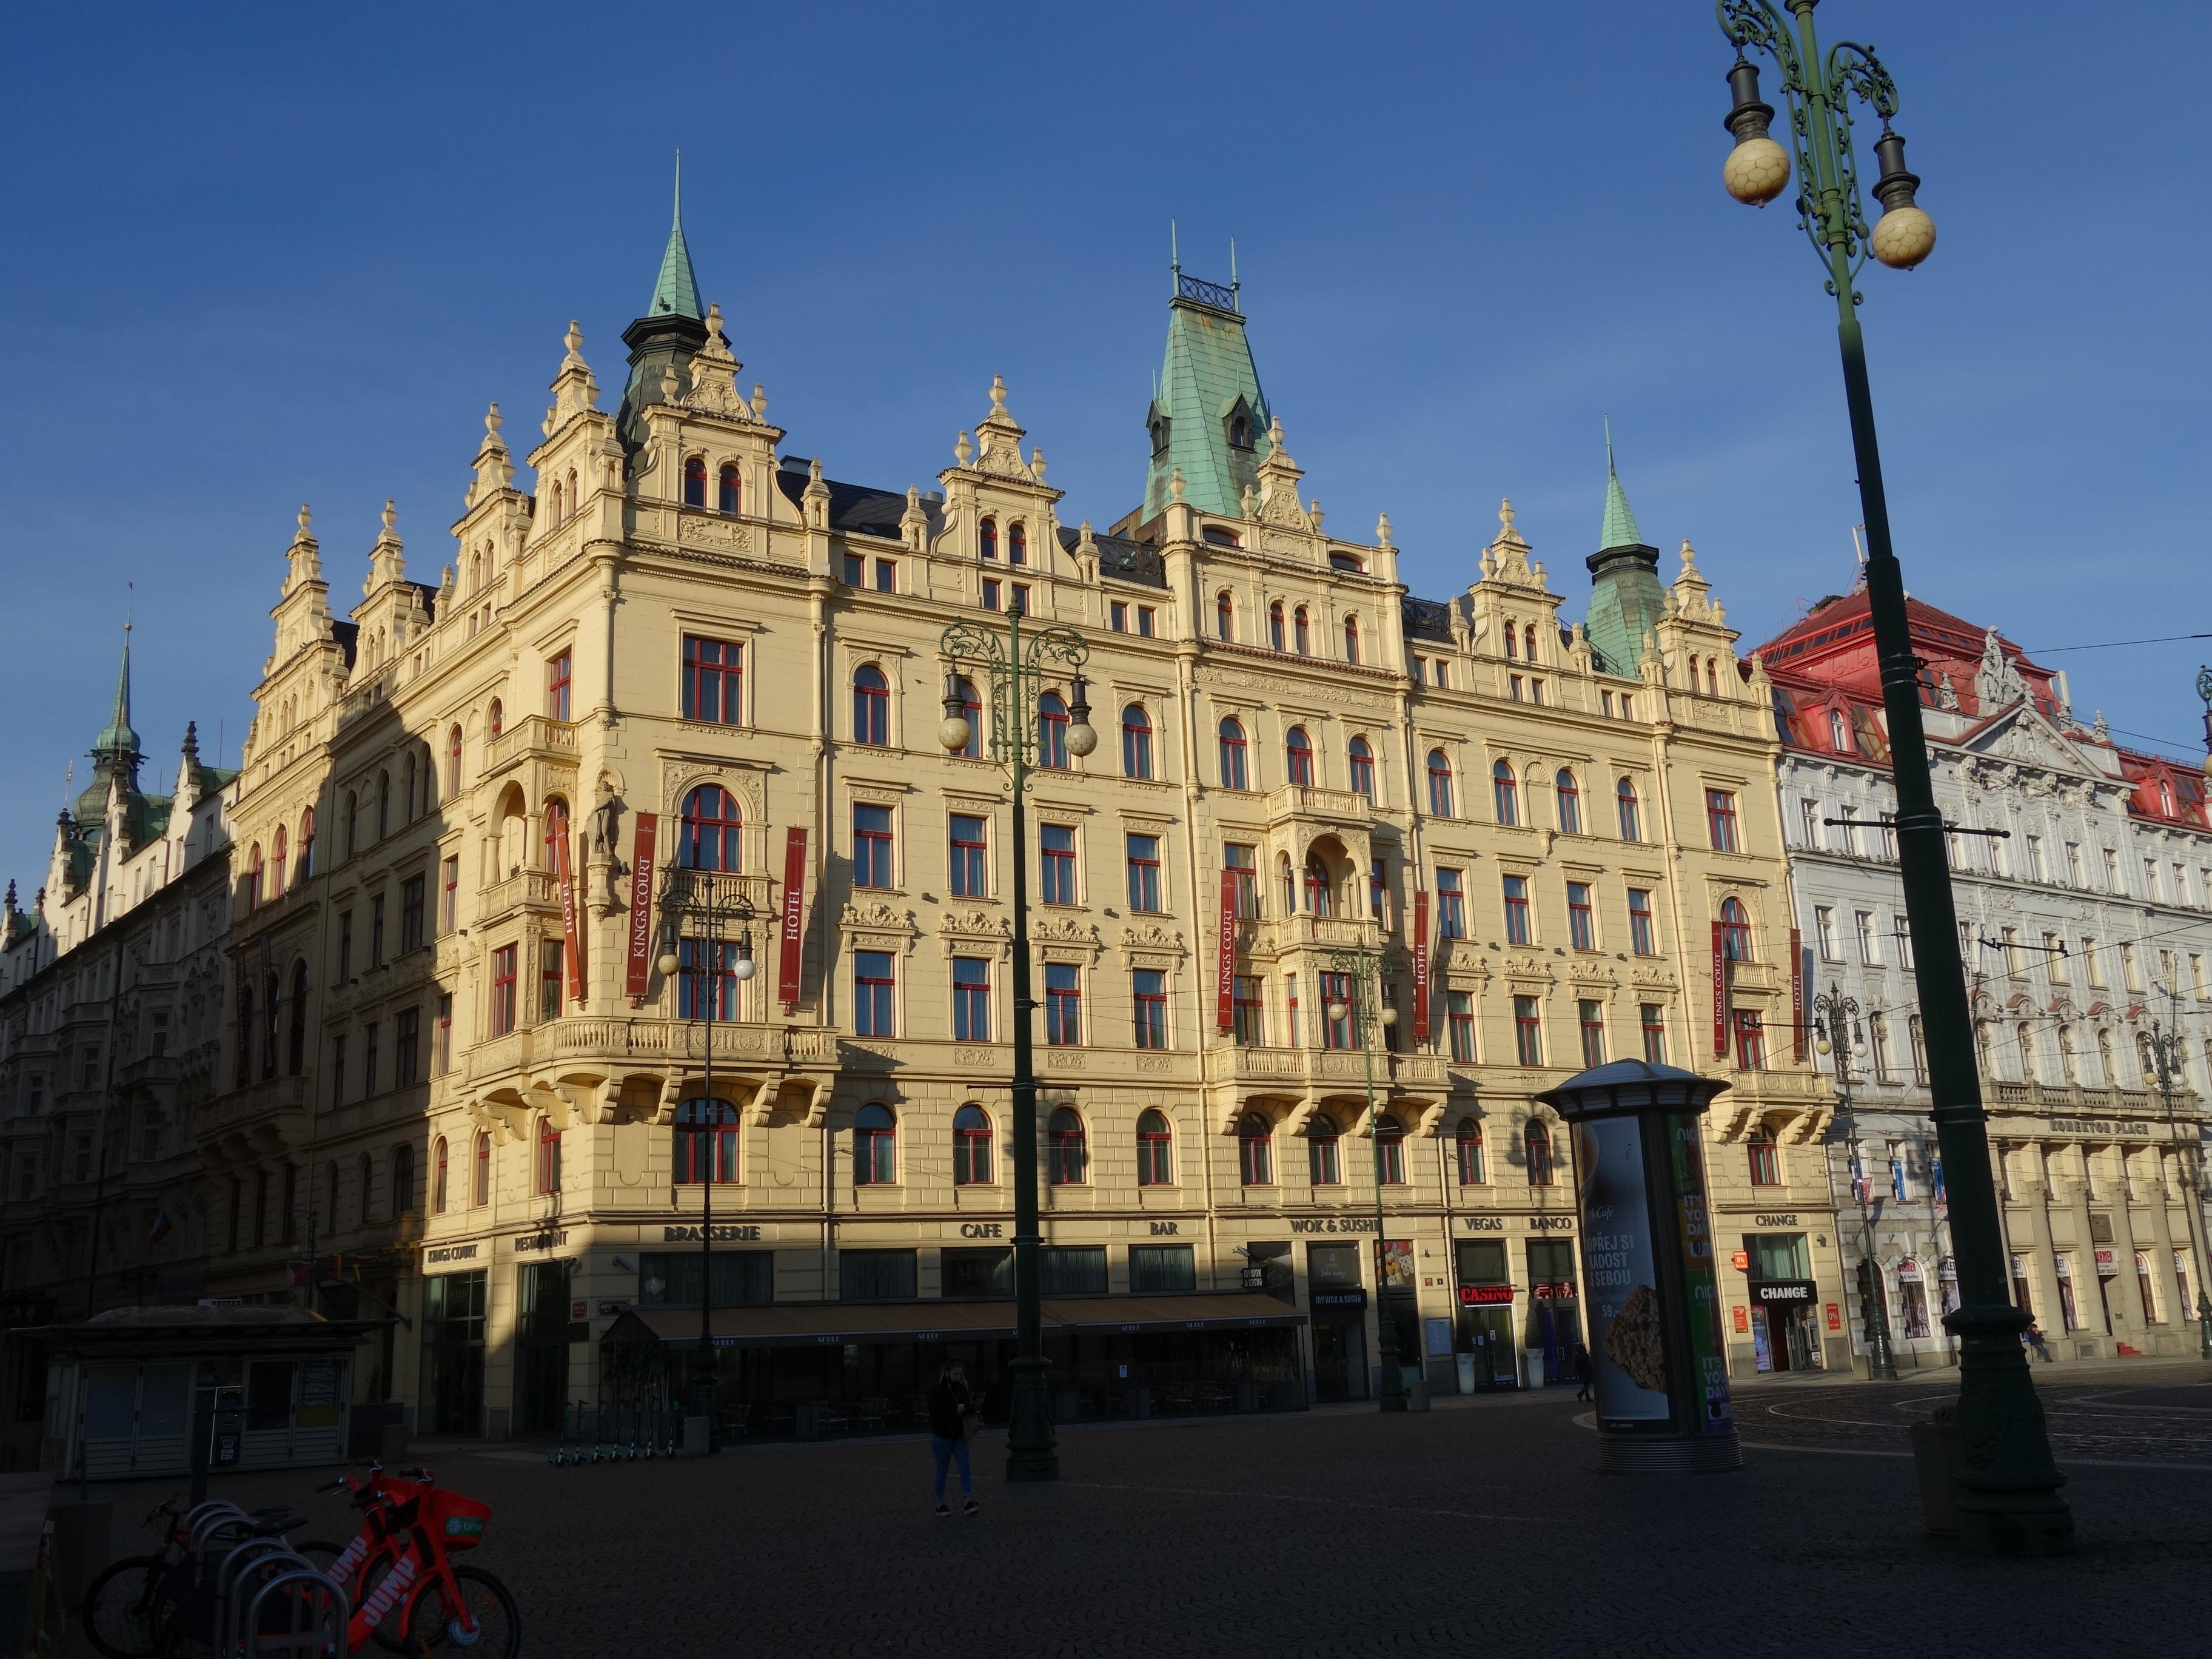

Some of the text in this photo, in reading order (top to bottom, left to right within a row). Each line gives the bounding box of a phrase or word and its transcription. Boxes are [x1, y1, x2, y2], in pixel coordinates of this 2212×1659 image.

[563, 879, 573, 934] HOTEL
[634, 856, 651, 957] KINGS COURT
[786, 888, 800, 940] HOTEL
[1222, 907, 1232, 994] KINGS COURT
[1417, 941, 1426, 985] HOTEL
[2048, 1119, 2149, 1135] KONEKTOR PLACE
[1150, 1221, 1181, 1235] BAR
[1289, 1219, 1326, 1233] WOK
[1327, 1219, 1338, 1232] &
[1464, 1218, 1503, 1230] VEGAS
[1529, 1217, 1572, 1230] BANCO
[1755, 1215, 1798, 1226] CHANGE
[960, 1223, 1002, 1238] CAFE
[514, 1230, 569, 1252] RESTAURANT
[1620, 1234, 1635, 1250] SI
[428, 1244, 478, 1264] KINGS COURT
[1589, 1252, 1628, 1269] RADOST
[1596, 1270, 1631, 1287] SEBOU
[1460, 1286, 1513, 1302] CASINO
[1760, 1287, 1808, 1299] CHANGE
[327, 1535, 368, 1584] UMP
[363, 1555, 417, 1627] JUMP
